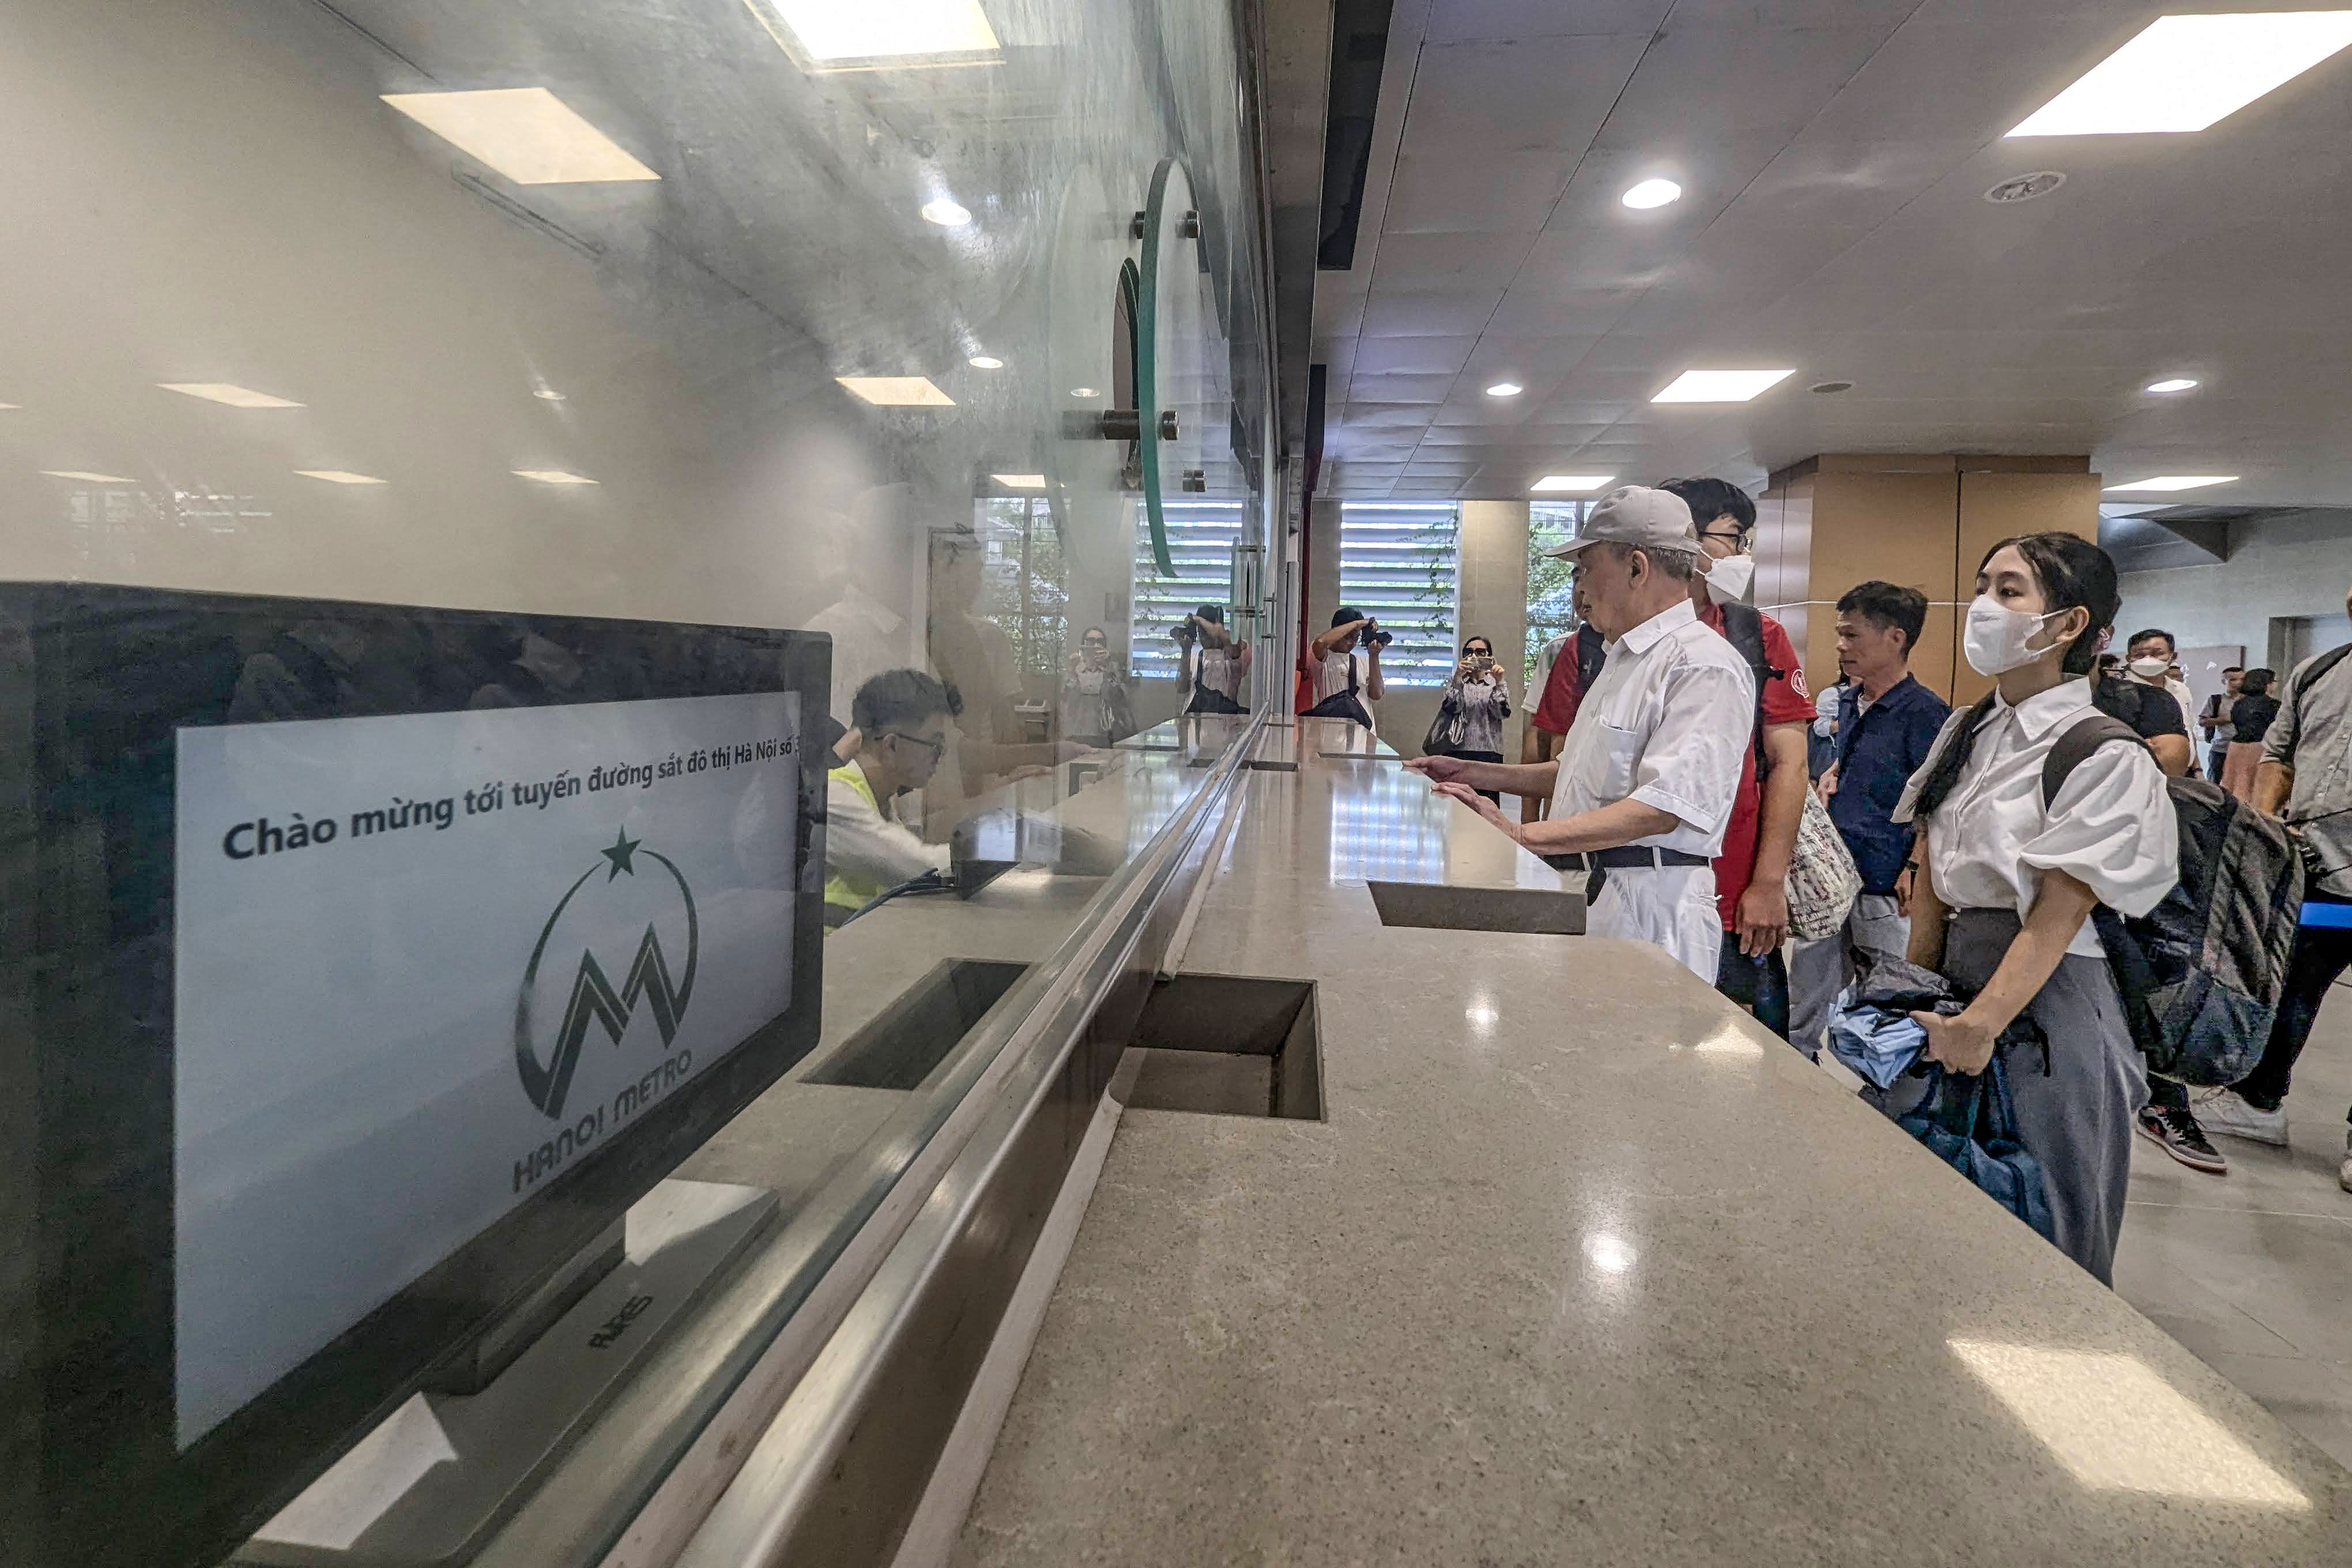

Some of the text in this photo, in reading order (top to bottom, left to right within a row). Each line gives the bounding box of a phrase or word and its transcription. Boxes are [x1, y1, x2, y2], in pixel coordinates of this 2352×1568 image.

[223, 813, 337, 860] Chào
[351, 797, 454, 838] mừng
[463, 781, 503, 816] tới
[512, 770, 581, 810] tuyến
[588, 762, 653, 791] đường
[658, 752, 683, 779] sắt
[687, 750, 707, 773] đô
[711, 746, 730, 770] thị
[734, 742, 752, 764] Hà
[756, 738, 777, 763] Nội
[779, 734, 793, 756] số
[512, 1049, 691, 1193] HANOI METRO
